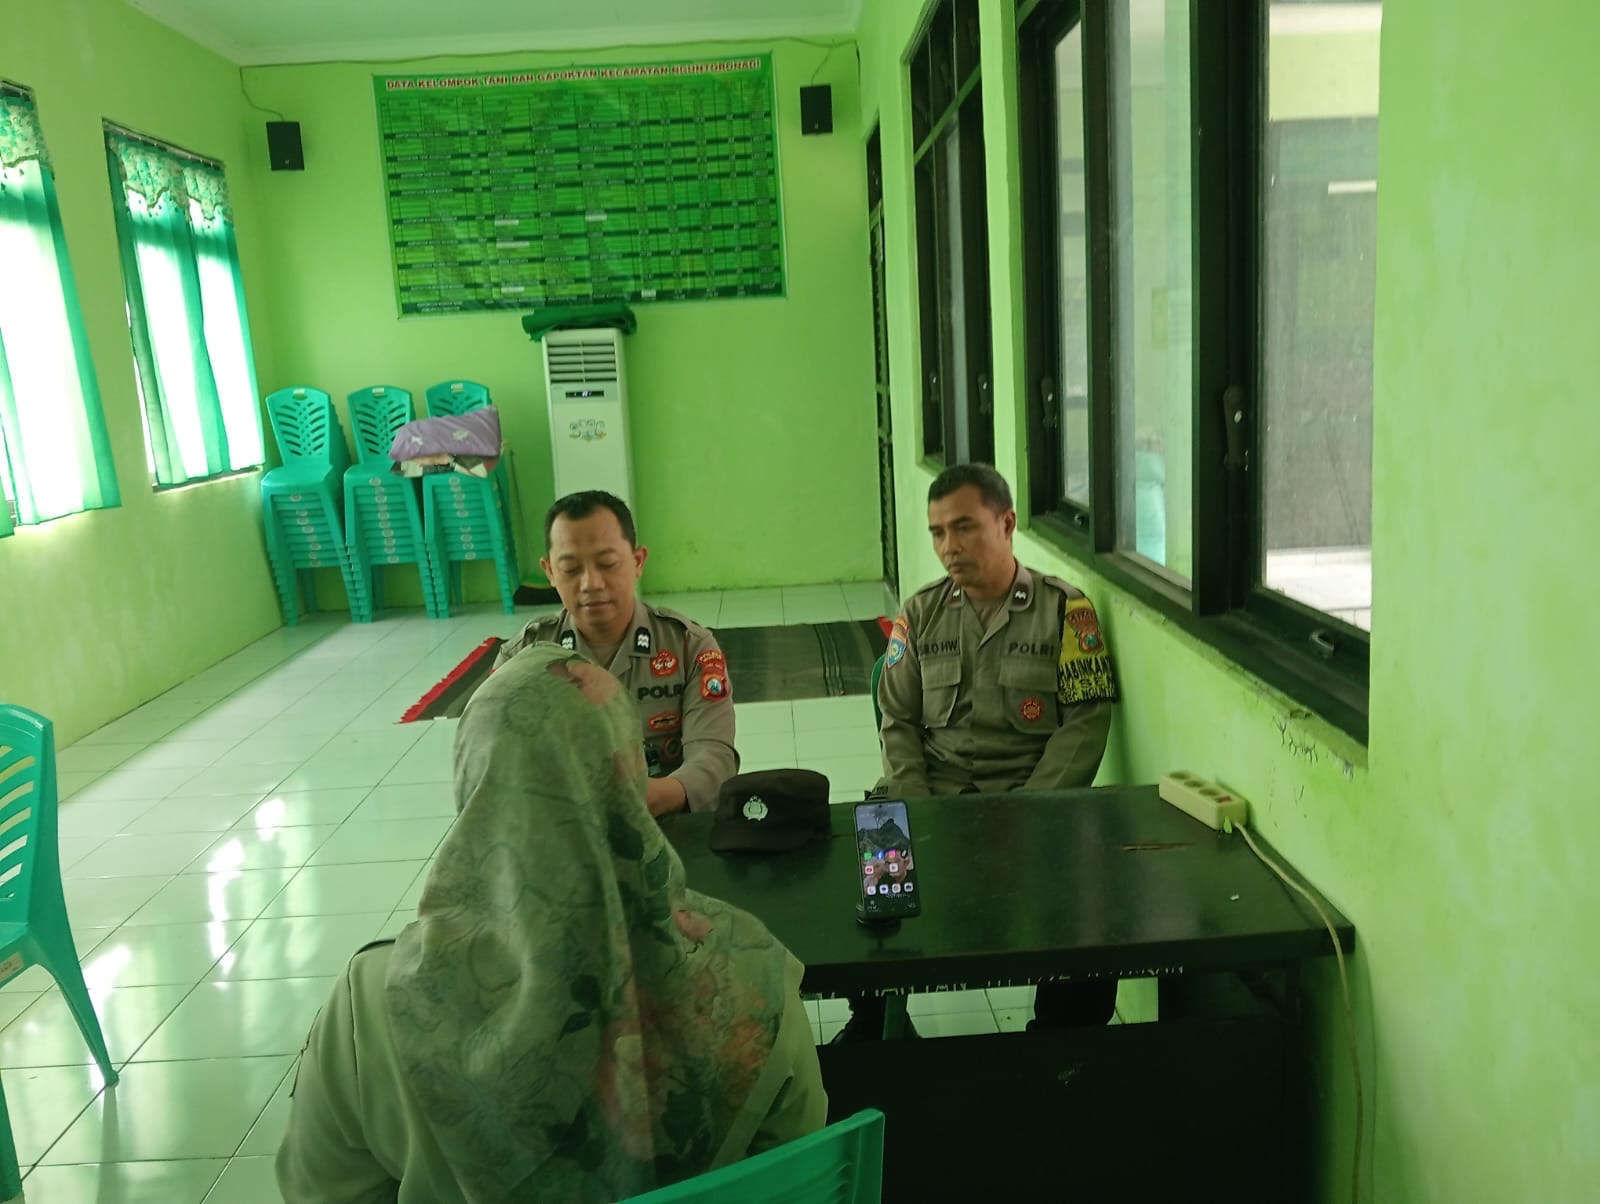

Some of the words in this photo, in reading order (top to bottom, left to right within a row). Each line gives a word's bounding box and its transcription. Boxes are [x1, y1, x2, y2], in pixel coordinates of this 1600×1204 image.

[386, 79, 415, 90] DATA
[417, 77, 479, 90] KELOMPOK
[483, 75, 508, 87] TANI
[511, 73, 534, 85] DAN
[600, 65, 670, 80] KECAMATAN
[1009, 642, 1054, 657] POLRI
